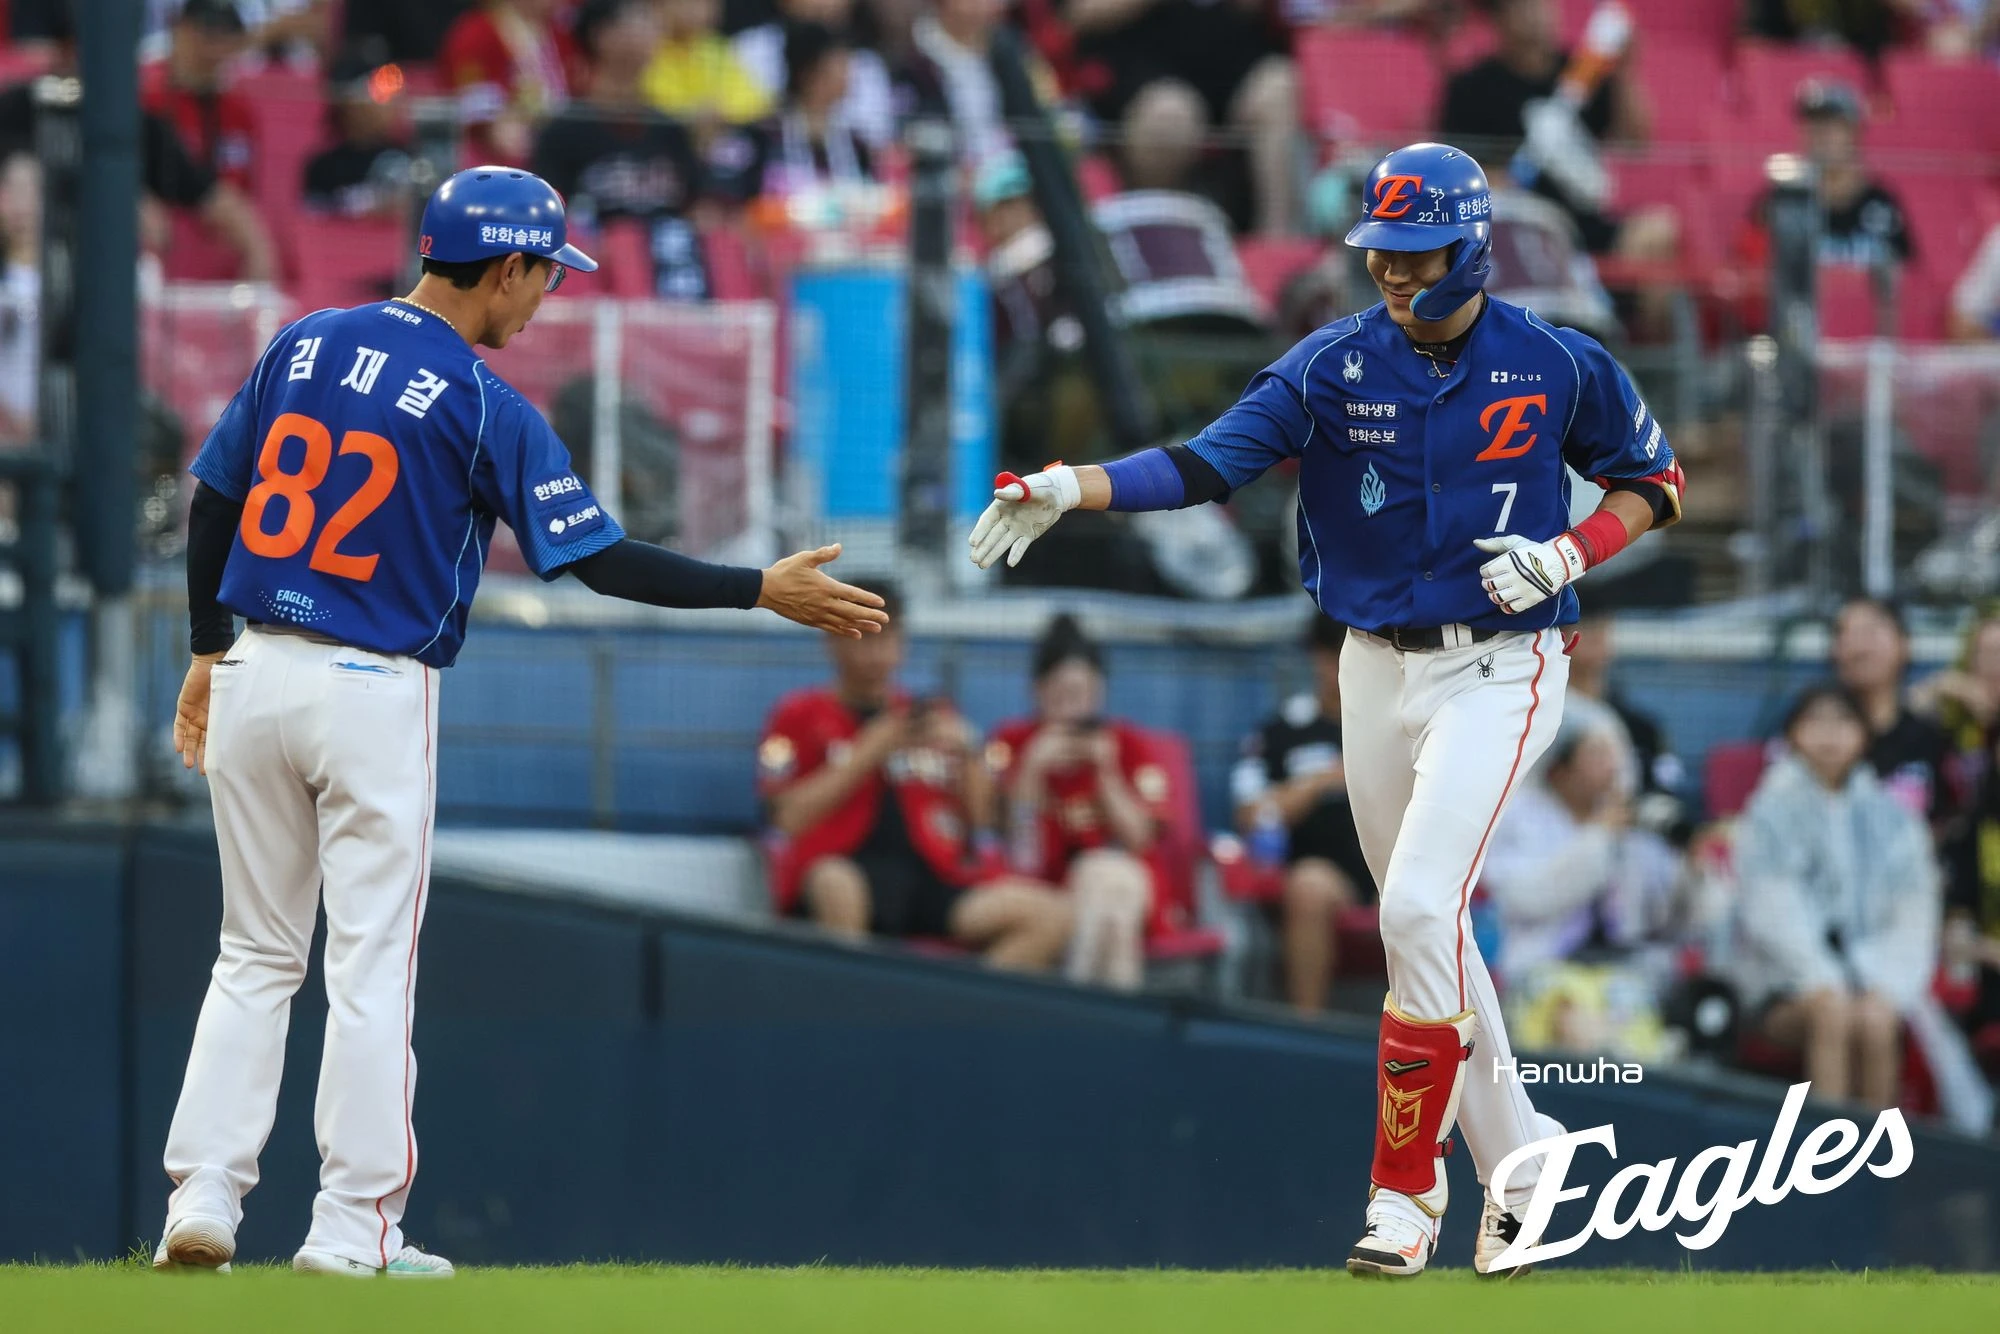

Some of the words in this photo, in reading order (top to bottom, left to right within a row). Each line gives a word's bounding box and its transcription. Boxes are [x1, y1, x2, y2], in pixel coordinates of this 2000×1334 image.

[1370, 173, 1423, 219] E
[1430, 187, 1445, 200] 53
[1433, 200, 1440, 211] 1
[419, 235, 433, 254] 82
[481, 226, 552, 247] 한화솔루션
[1511, 374, 1542, 382] PLUS
[1345, 403, 1396, 418] 한화생명
[1348, 428, 1396, 444] 한화손보
[1475, 394, 1546, 461] E
[240, 412, 399, 582] 82
[1491, 482, 1517, 532] 7
[566, 505, 600, 527] 토스페이
[276, 589, 315, 610] EAGLES
